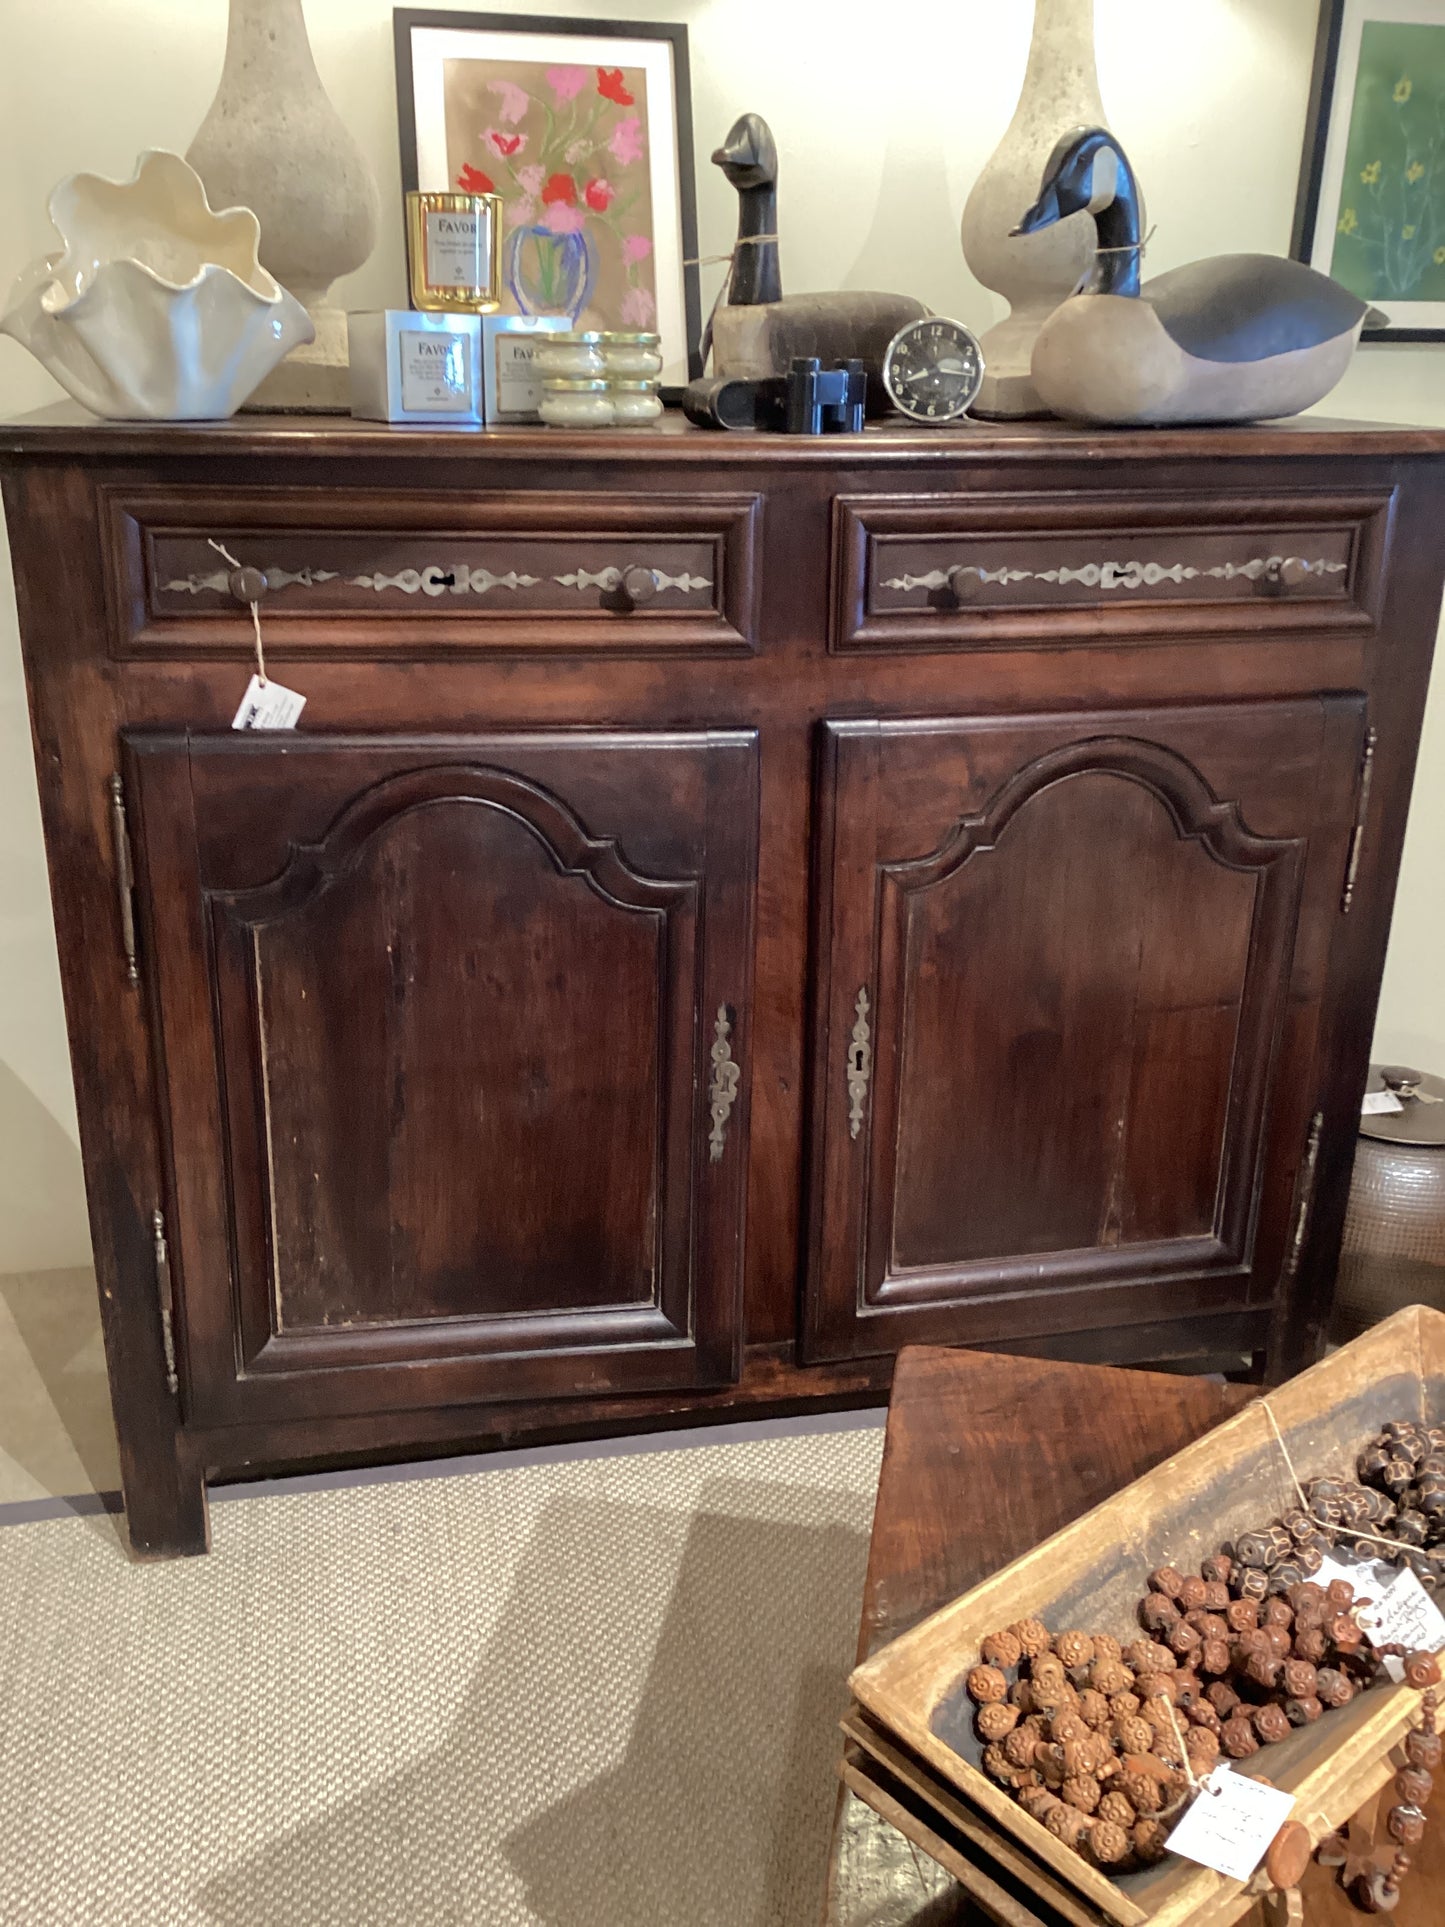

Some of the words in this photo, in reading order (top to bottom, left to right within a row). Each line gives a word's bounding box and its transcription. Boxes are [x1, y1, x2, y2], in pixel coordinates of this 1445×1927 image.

[438, 219, 477, 233] FAVOR
[931, 325, 943, 337] 12
[418, 342, 448, 356] FAVO
[966, 345, 973, 356] 2
[892, 364, 900, 375] 9
[896, 383, 904, 395] 8
[960, 385, 970, 396] 4
[927, 405, 935, 416] 6
[948, 400, 955, 411] 5
